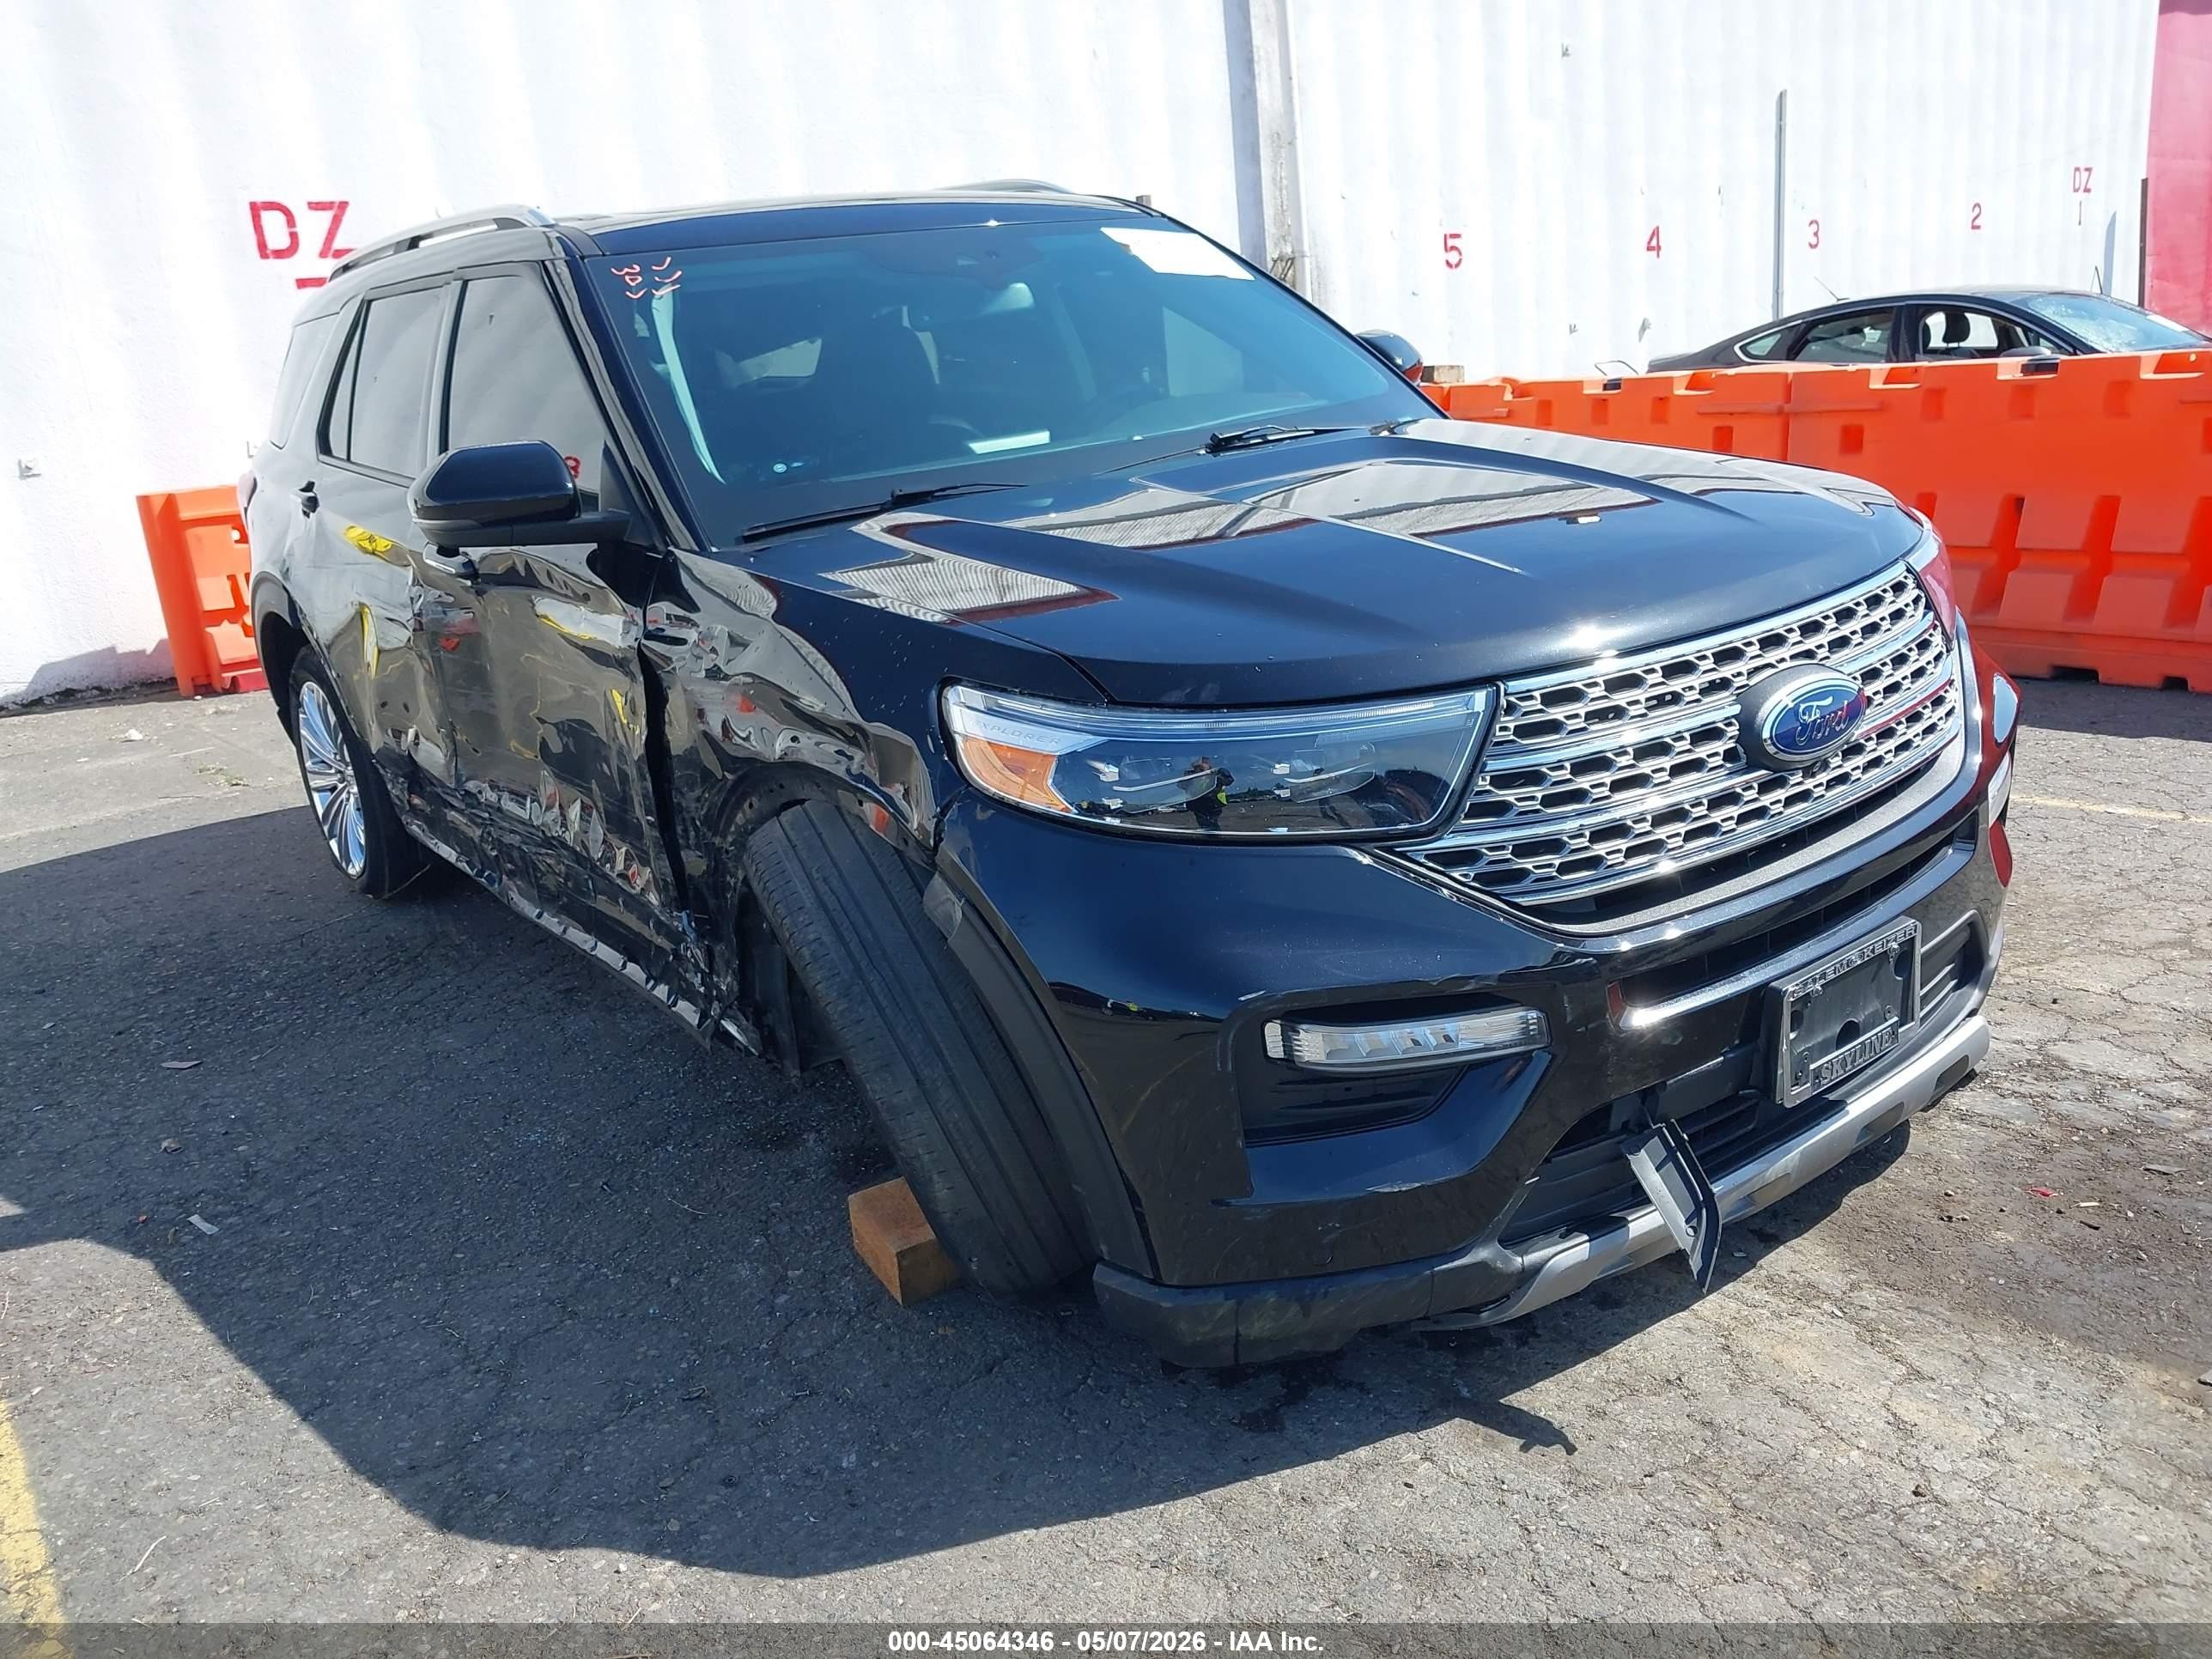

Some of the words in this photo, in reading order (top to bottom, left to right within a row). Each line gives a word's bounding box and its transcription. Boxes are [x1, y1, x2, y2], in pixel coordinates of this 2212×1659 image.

[2073, 166, 2094, 194] DZ
[248, 200, 357, 260] DZ
[1808, 219, 1820, 249] 3
[1970, 203, 1982, 231] 2
[1443, 233, 1463, 270] 5
[1645, 225, 1662, 259] 4
[969, 720, 1061, 745] EXPLORER
[1795, 696, 1850, 746] Ford
[1820, 1028, 1894, 1085] SKYLINE
